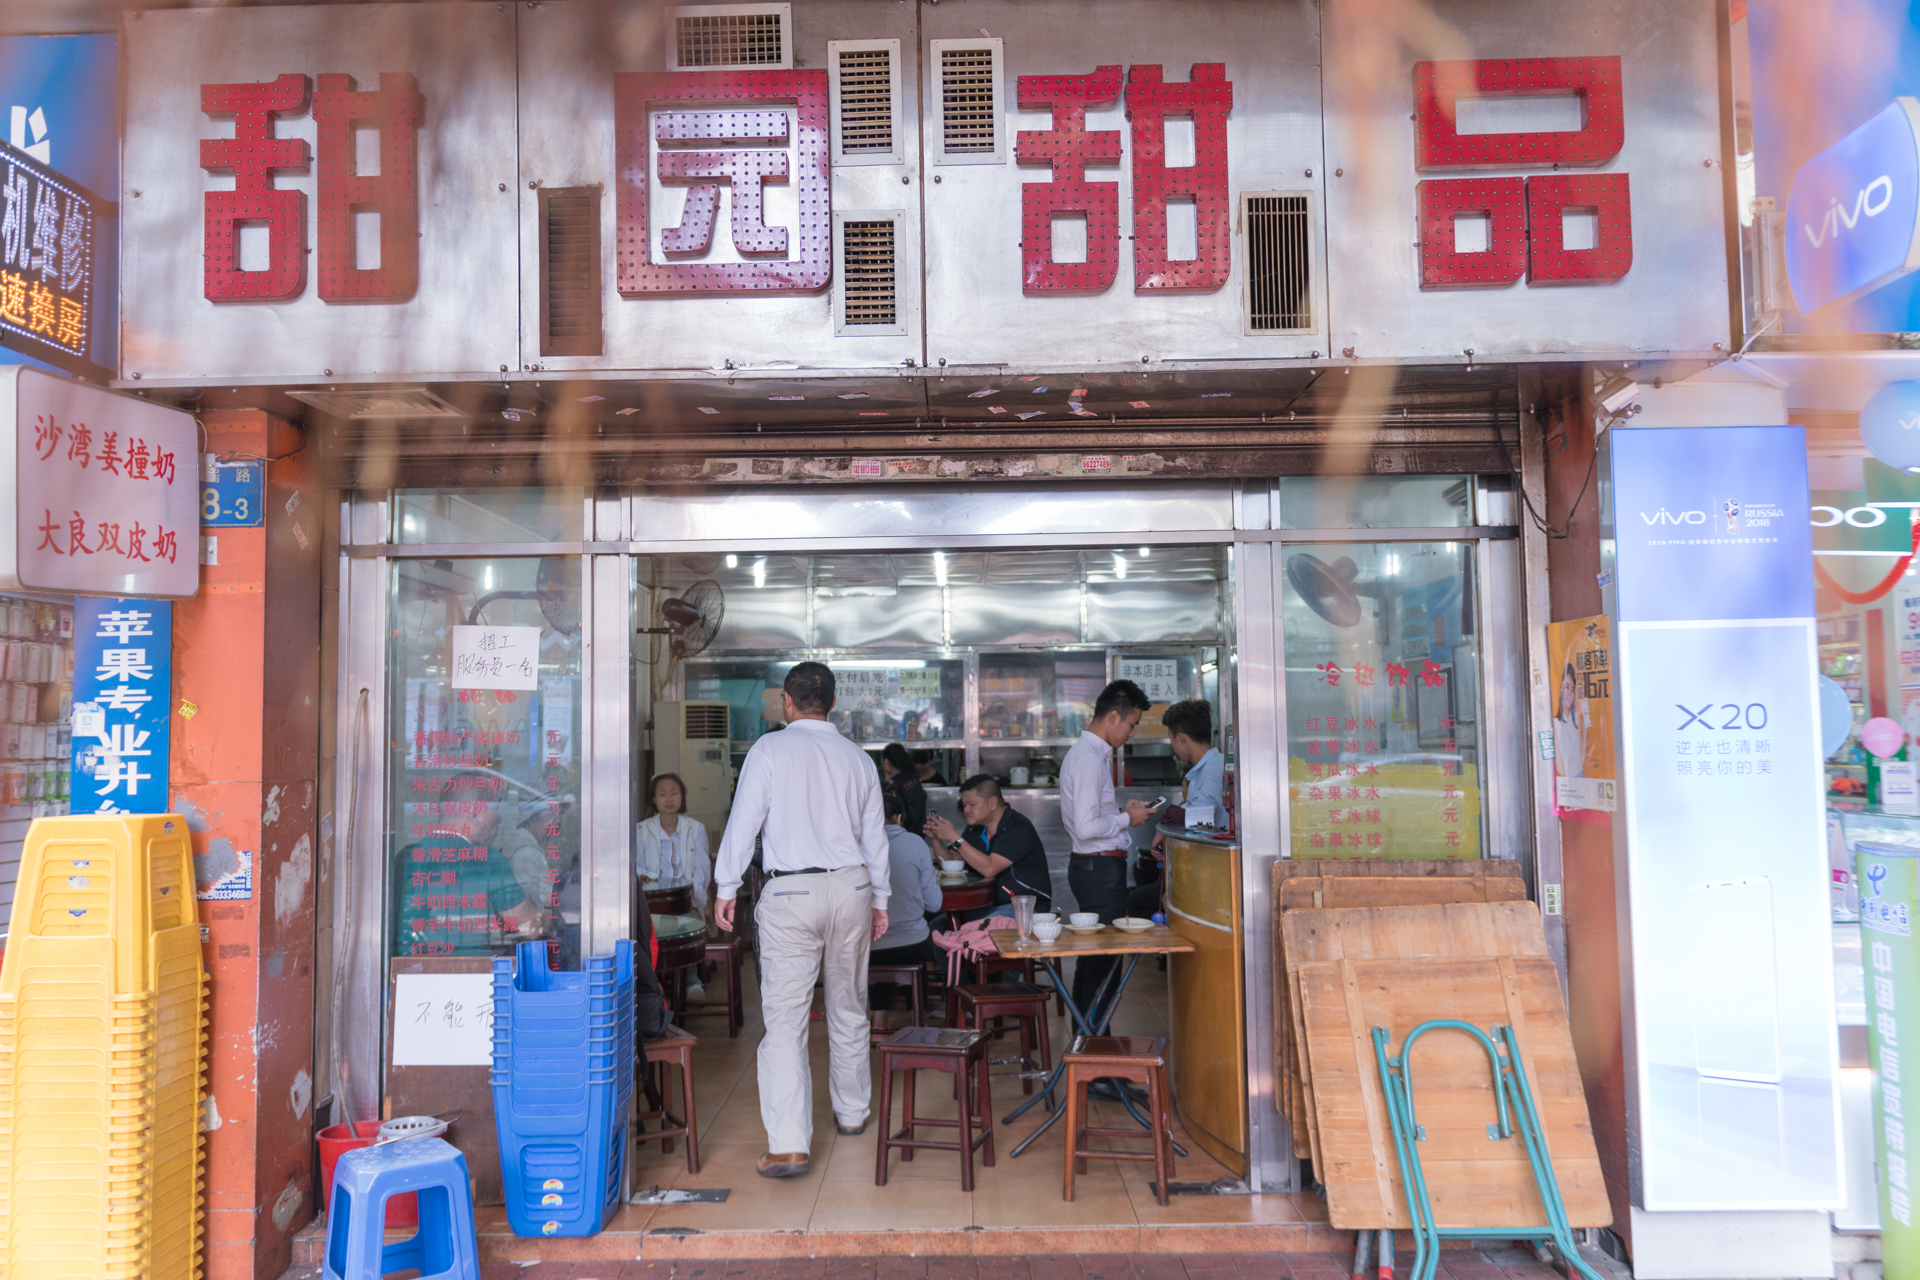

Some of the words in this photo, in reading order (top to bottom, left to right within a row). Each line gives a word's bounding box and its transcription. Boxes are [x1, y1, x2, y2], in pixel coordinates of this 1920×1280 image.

[200, 55, 1633, 304] 甜园甜品
[1805, 174, 1893, 249] vivo
[1, 164, 85, 292] 机维修
[0, 269, 84, 348] 速换屏
[34, 414, 176, 486] 沙湾姜撞奶
[201, 488, 249, 520] 8-3
[1640, 507, 1706, 526] vivo
[1744, 509, 1784, 518] RUSSIA
[1745, 518, 1770, 527] 2018
[36, 508, 178, 564] 大良双皮奶
[477, 631, 516, 652] 招工
[456, 652, 534, 679] 服务员一名
[1123, 664, 1174, 678] 非本店员工
[1316, 660, 1446, 687] 冷热饮品
[1306, 715, 1378, 731] 红豆冰水
[1440, 714, 1456, 730] 元
[1675, 702, 1768, 731] X20
[413, 730, 520, 746] 番禺特产姜撞奶
[546, 730, 561, 744] 元
[1307, 739, 1379, 755] 菠萝冰水
[1441, 738, 1456, 752] 元
[1676, 739, 1771, 756] 逆光也清晰
[413, 753, 489, 769] 香滑炒旦奶
[546, 753, 561, 767] 元
[1308, 762, 1380, 777] 西瓜冰水
[1442, 761, 1458, 776] 元
[1677, 759, 1772, 776] 照亮你的美
[546, 776, 561, 790] 元
[1309, 785, 1381, 801] 杂果冰水
[1443, 785, 1458, 799] 元
[412, 800, 488, 815] 大良双皮奶
[546, 800, 561, 814] 元
[1444, 808, 1459, 823] 元
[412, 823, 473, 839] 牛奶汤丸
[1310, 832, 1382, 848] 杂果冰球
[1444, 831, 1460, 847] 元
[411, 847, 489, 863] 香滑芝麻糊
[545, 845, 561, 861] 元
[411, 870, 457, 886] 杏仁糊
[545, 869, 561, 884] 元
[411, 893, 488, 910] 牛奶西米露
[545, 892, 561, 908] 元
[411, 916, 519, 933] 香芋牛奶西米露
[411, 941, 456, 957] 红豆沙
